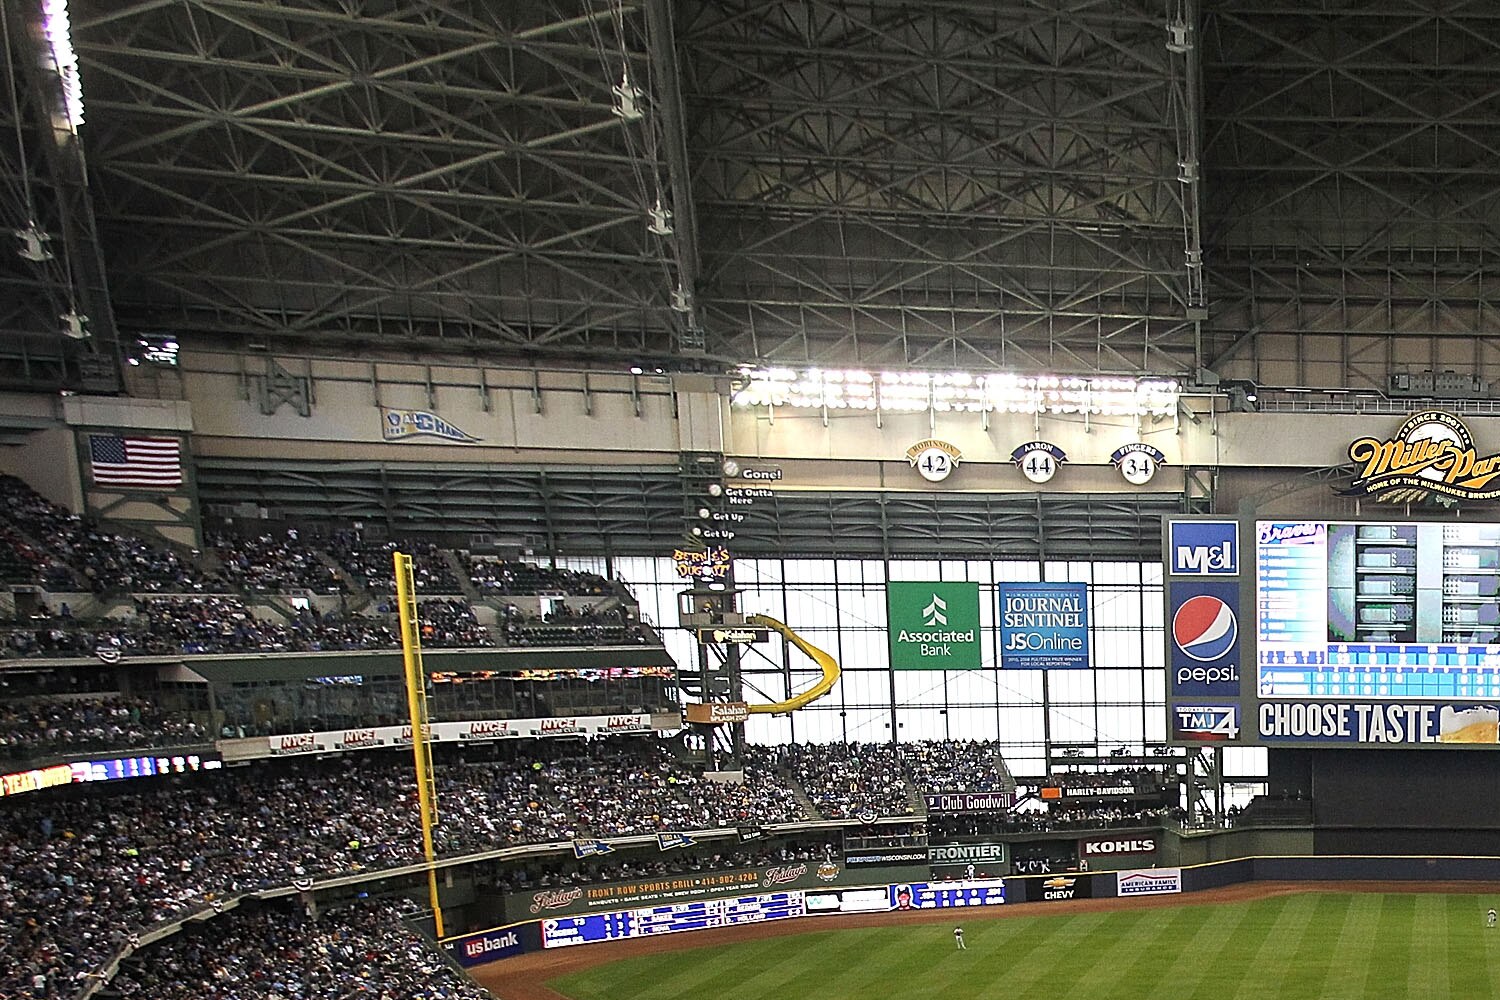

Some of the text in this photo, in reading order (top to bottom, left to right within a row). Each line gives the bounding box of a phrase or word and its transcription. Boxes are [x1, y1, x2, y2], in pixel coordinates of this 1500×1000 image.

[1407, 414, 1459, 430] SINCE 2001
[912, 440, 954, 452] ROBINSON
[1024, 441, 1053, 452] AARON
[1119, 444, 1156, 456] FINGERS
[921, 455, 948, 473] 42
[1350, 438, 1453, 478] Miller
[1026, 457, 1052, 475] 44
[1126, 458, 1150, 476] 34
[743, 470, 782, 480] Gone!
[725, 488, 773, 497] Get Outta
[1367, 478, 1389, 493] HOME
[1390, 477, 1401, 485] OF
[1403, 477, 1419, 486] THE
[1420, 480, 1467, 498] MILWAUKEE
[729, 497, 753, 505] Here
[713, 513, 744, 522] Get Up
[703, 530, 735, 540] Get Up
[1004, 598, 1084, 614] JOURNAL
[1004, 613, 1084, 628] SENTINEL
[898, 630, 974, 643] Associated
[1005, 632, 1083, 650] JSOnline
[920, 644, 952, 656] Bank
[1177, 664, 1235, 685] pepsi
[711, 705, 747, 716] Kalahari
[472, 722, 505, 732] NYCE
[543, 719, 575, 729] NYCE
[609, 716, 641, 726] NYCE
[1259, 703, 1441, 744] CHOOSE TASTE.
[282, 736, 315, 748] NYCE
[344, 731, 375, 743] NYCE
[1066, 786, 1134, 796] HARLEY-DAVIDSON
[941, 793, 1010, 810] Club Goodwill
[929, 845, 1001, 860] FRONTIER
[1086, 839, 1155, 854] KOHL'S
[763, 863, 808, 887] Friday's
[587, 880, 694, 899] FRONT ROW SPORTS GRILL
[1044, 890, 1074, 899] CHEVY
[530, 886, 583, 914] Friday's
